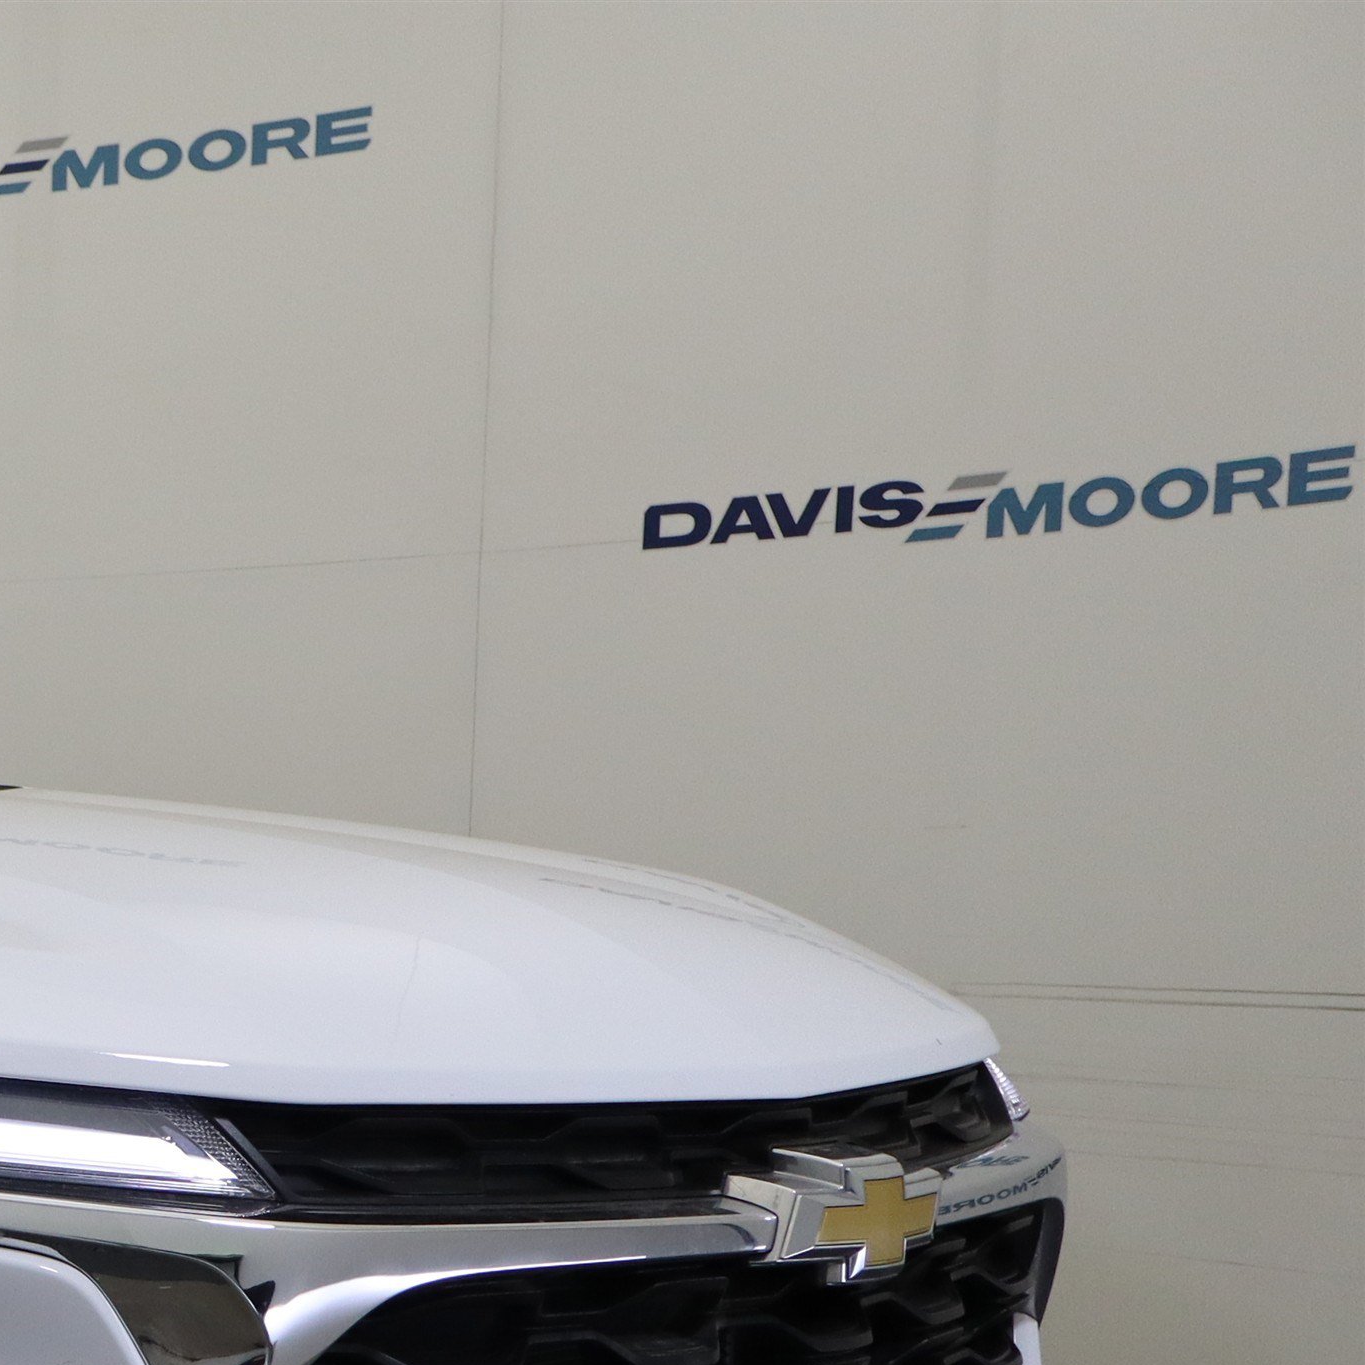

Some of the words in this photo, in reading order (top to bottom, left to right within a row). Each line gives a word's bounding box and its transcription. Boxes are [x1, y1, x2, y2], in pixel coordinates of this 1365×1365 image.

[51, 106, 373, 192] MOORE
[642, 480, 924, 550] DAVIS
[985, 444, 1357, 540] MOORE
